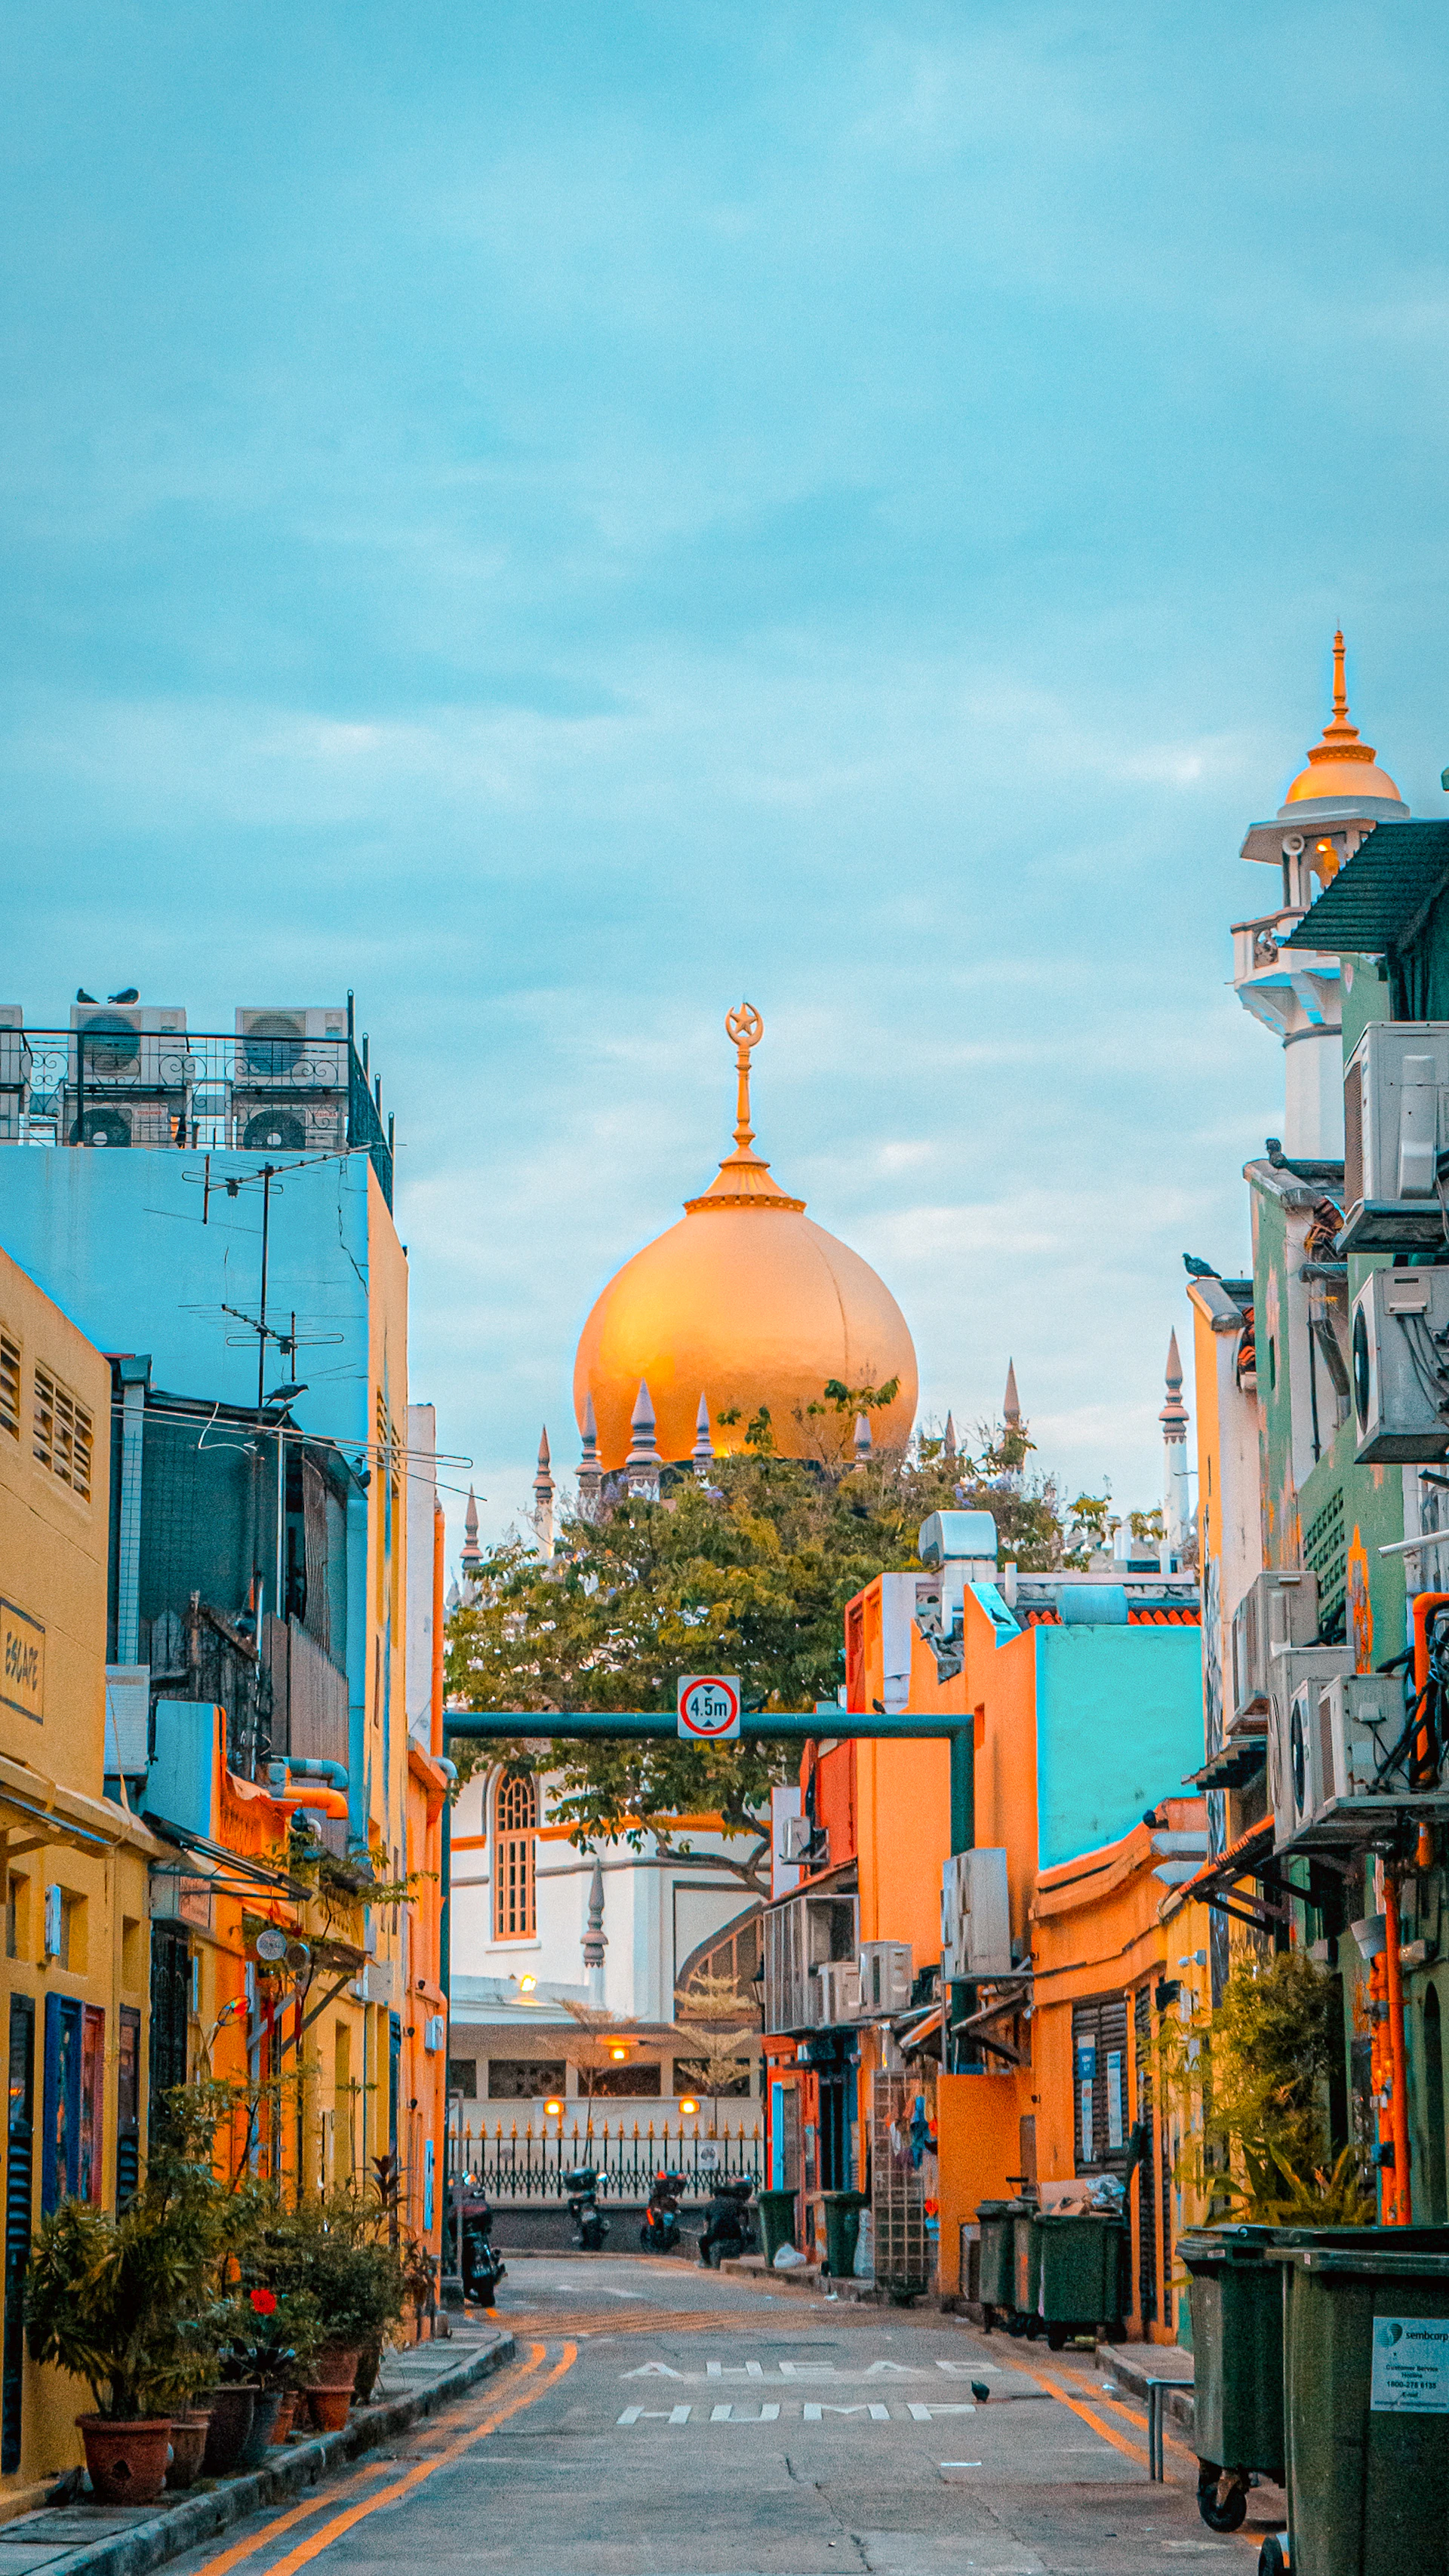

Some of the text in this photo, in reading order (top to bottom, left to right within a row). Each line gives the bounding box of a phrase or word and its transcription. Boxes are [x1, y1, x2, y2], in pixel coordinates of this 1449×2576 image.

[691, 1696, 727, 1717] 4.5m
[1405, 2330, 1449, 2343] sembcorp
[617, 2359, 1002, 2379] AHEAD
[615, 2403, 977, 2424] HUMP
